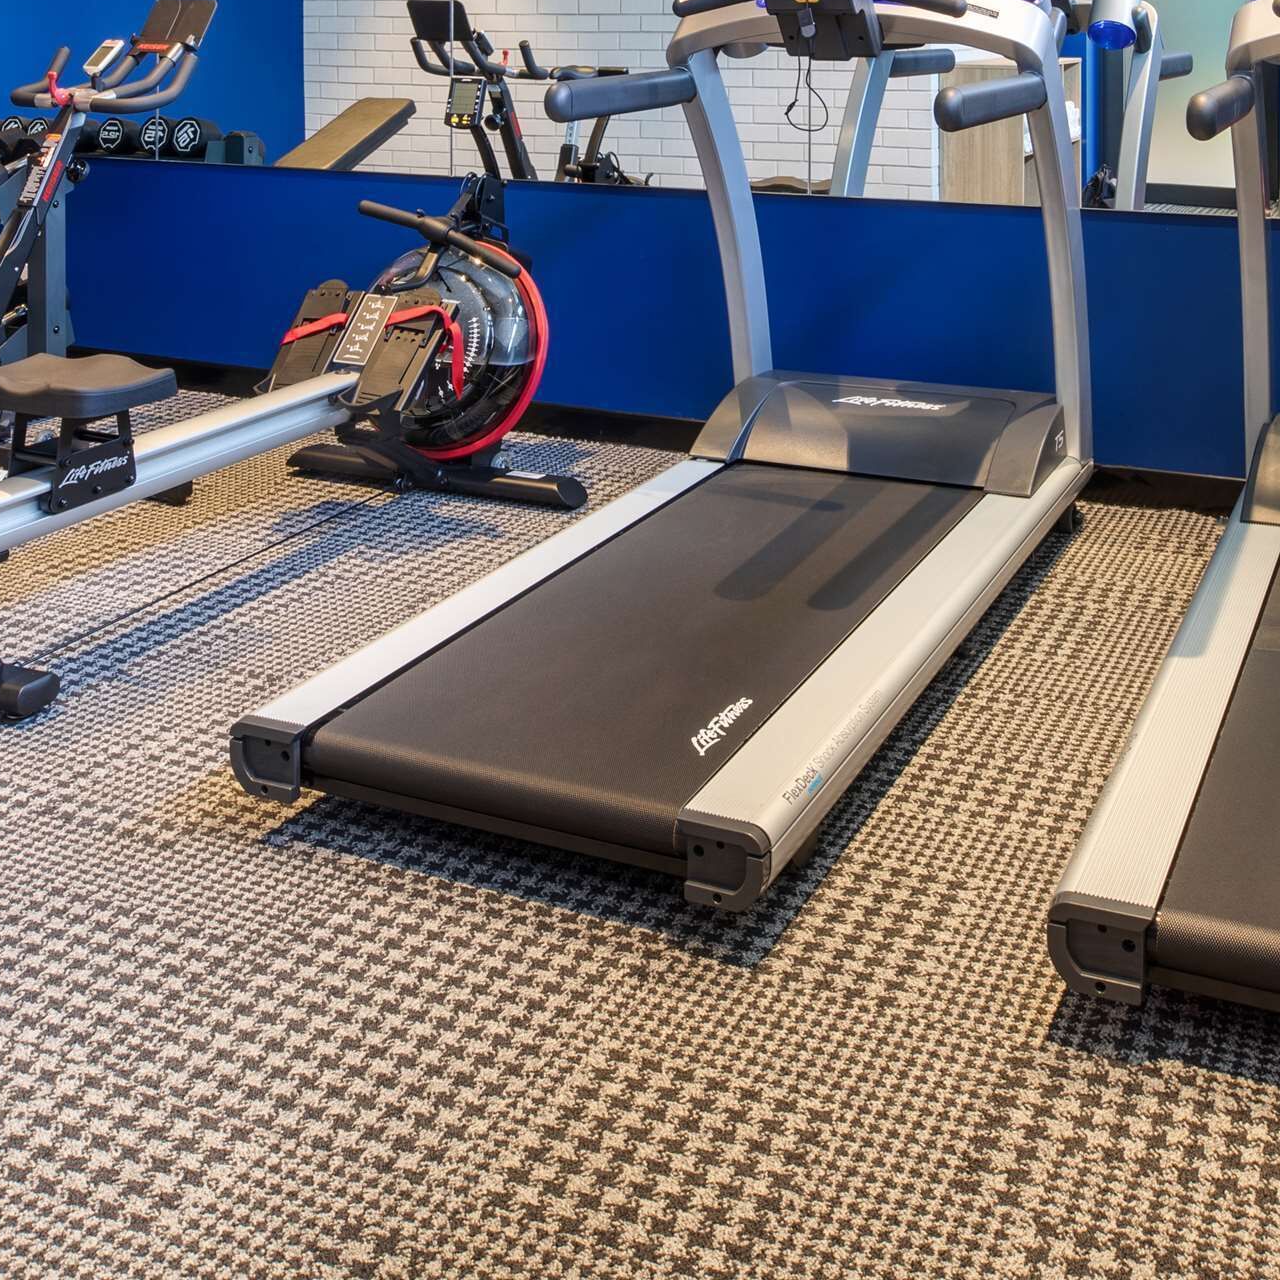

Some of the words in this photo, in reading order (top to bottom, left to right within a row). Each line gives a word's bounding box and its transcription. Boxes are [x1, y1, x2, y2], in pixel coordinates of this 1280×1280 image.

[59, 464, 86, 489] Life
[86, 455, 129, 481] Fitness
[782, 765, 818, 805] FlexDeck
